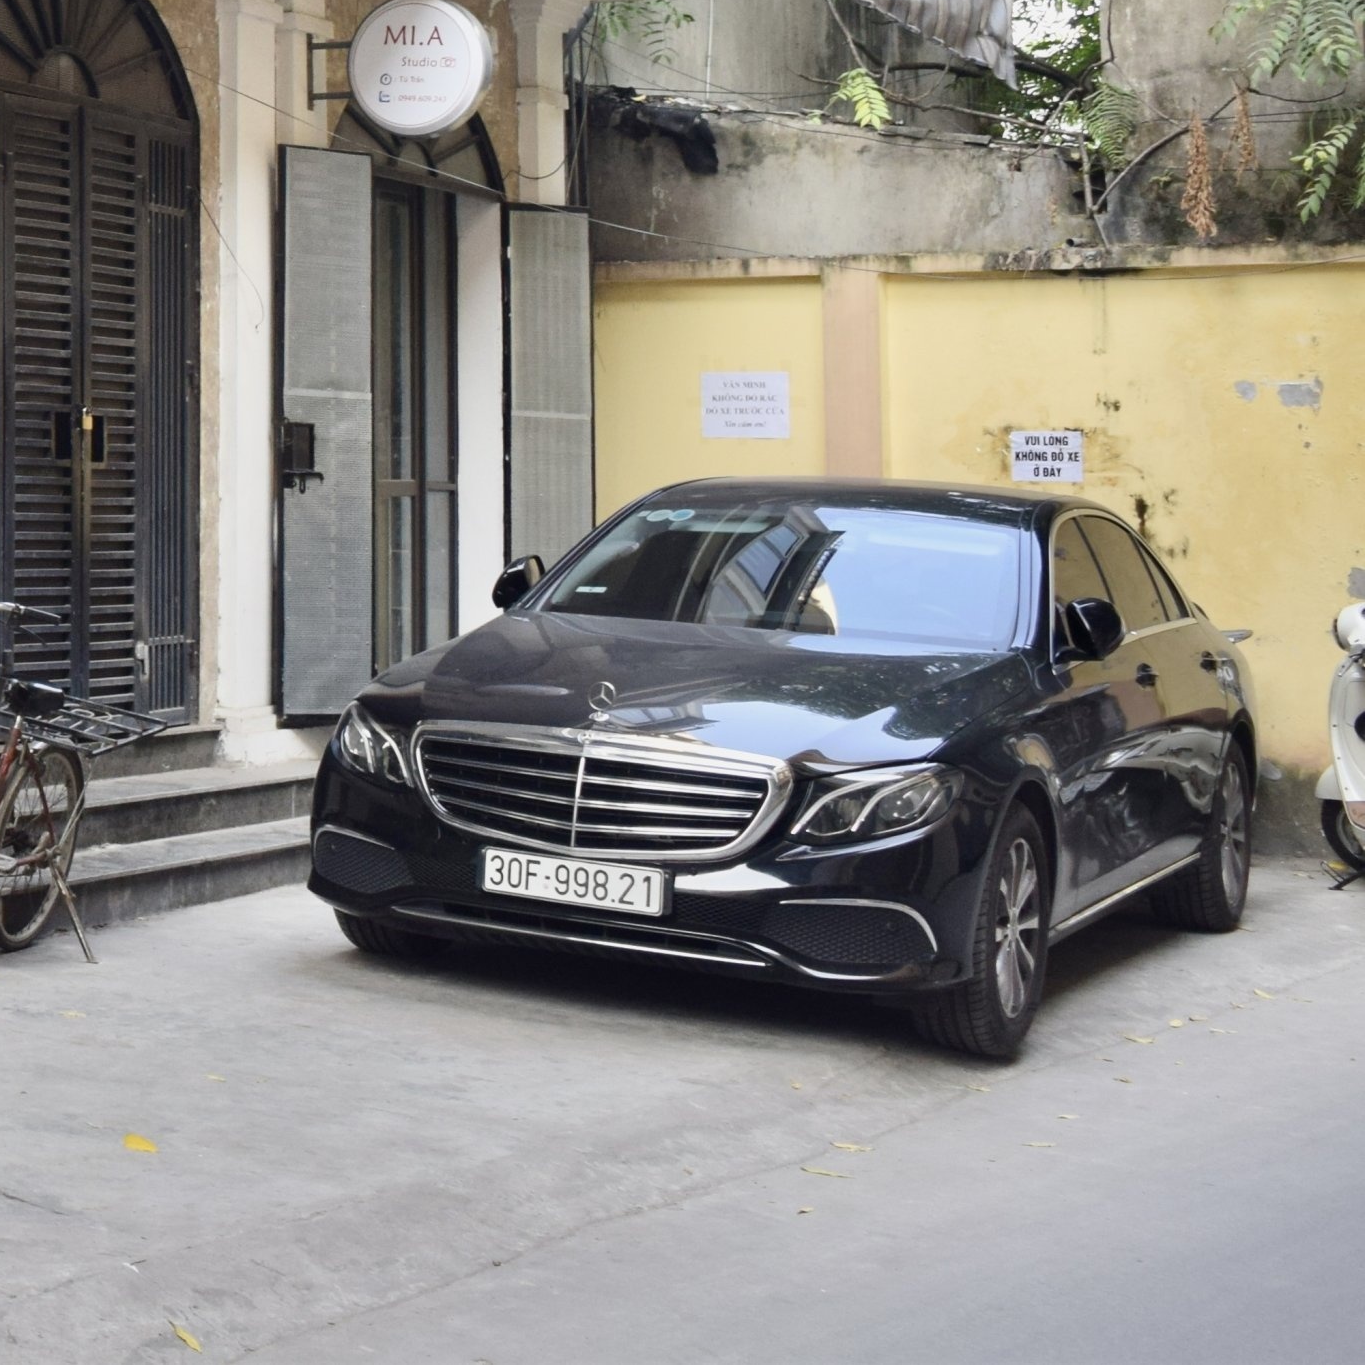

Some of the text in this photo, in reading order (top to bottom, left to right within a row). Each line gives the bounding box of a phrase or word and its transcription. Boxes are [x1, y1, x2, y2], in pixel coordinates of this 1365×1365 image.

[383, 25, 443, 46] MI.A
[401, 56, 438, 67] Studio
[743, 381, 766, 389] MINH
[712, 392, 743, 402] KHÔNG
[720, 407, 730, 415] XE
[724, 420, 737, 428] Xin
[1024, 434, 1069, 446] VUI LÒNG
[1015, 449, 1048, 462] KHÔNG
[1067, 451, 1080, 462] XE
[1042, 465, 1062, 477] ĐÂY
[490, 854, 652, 908] 30F-998.21
